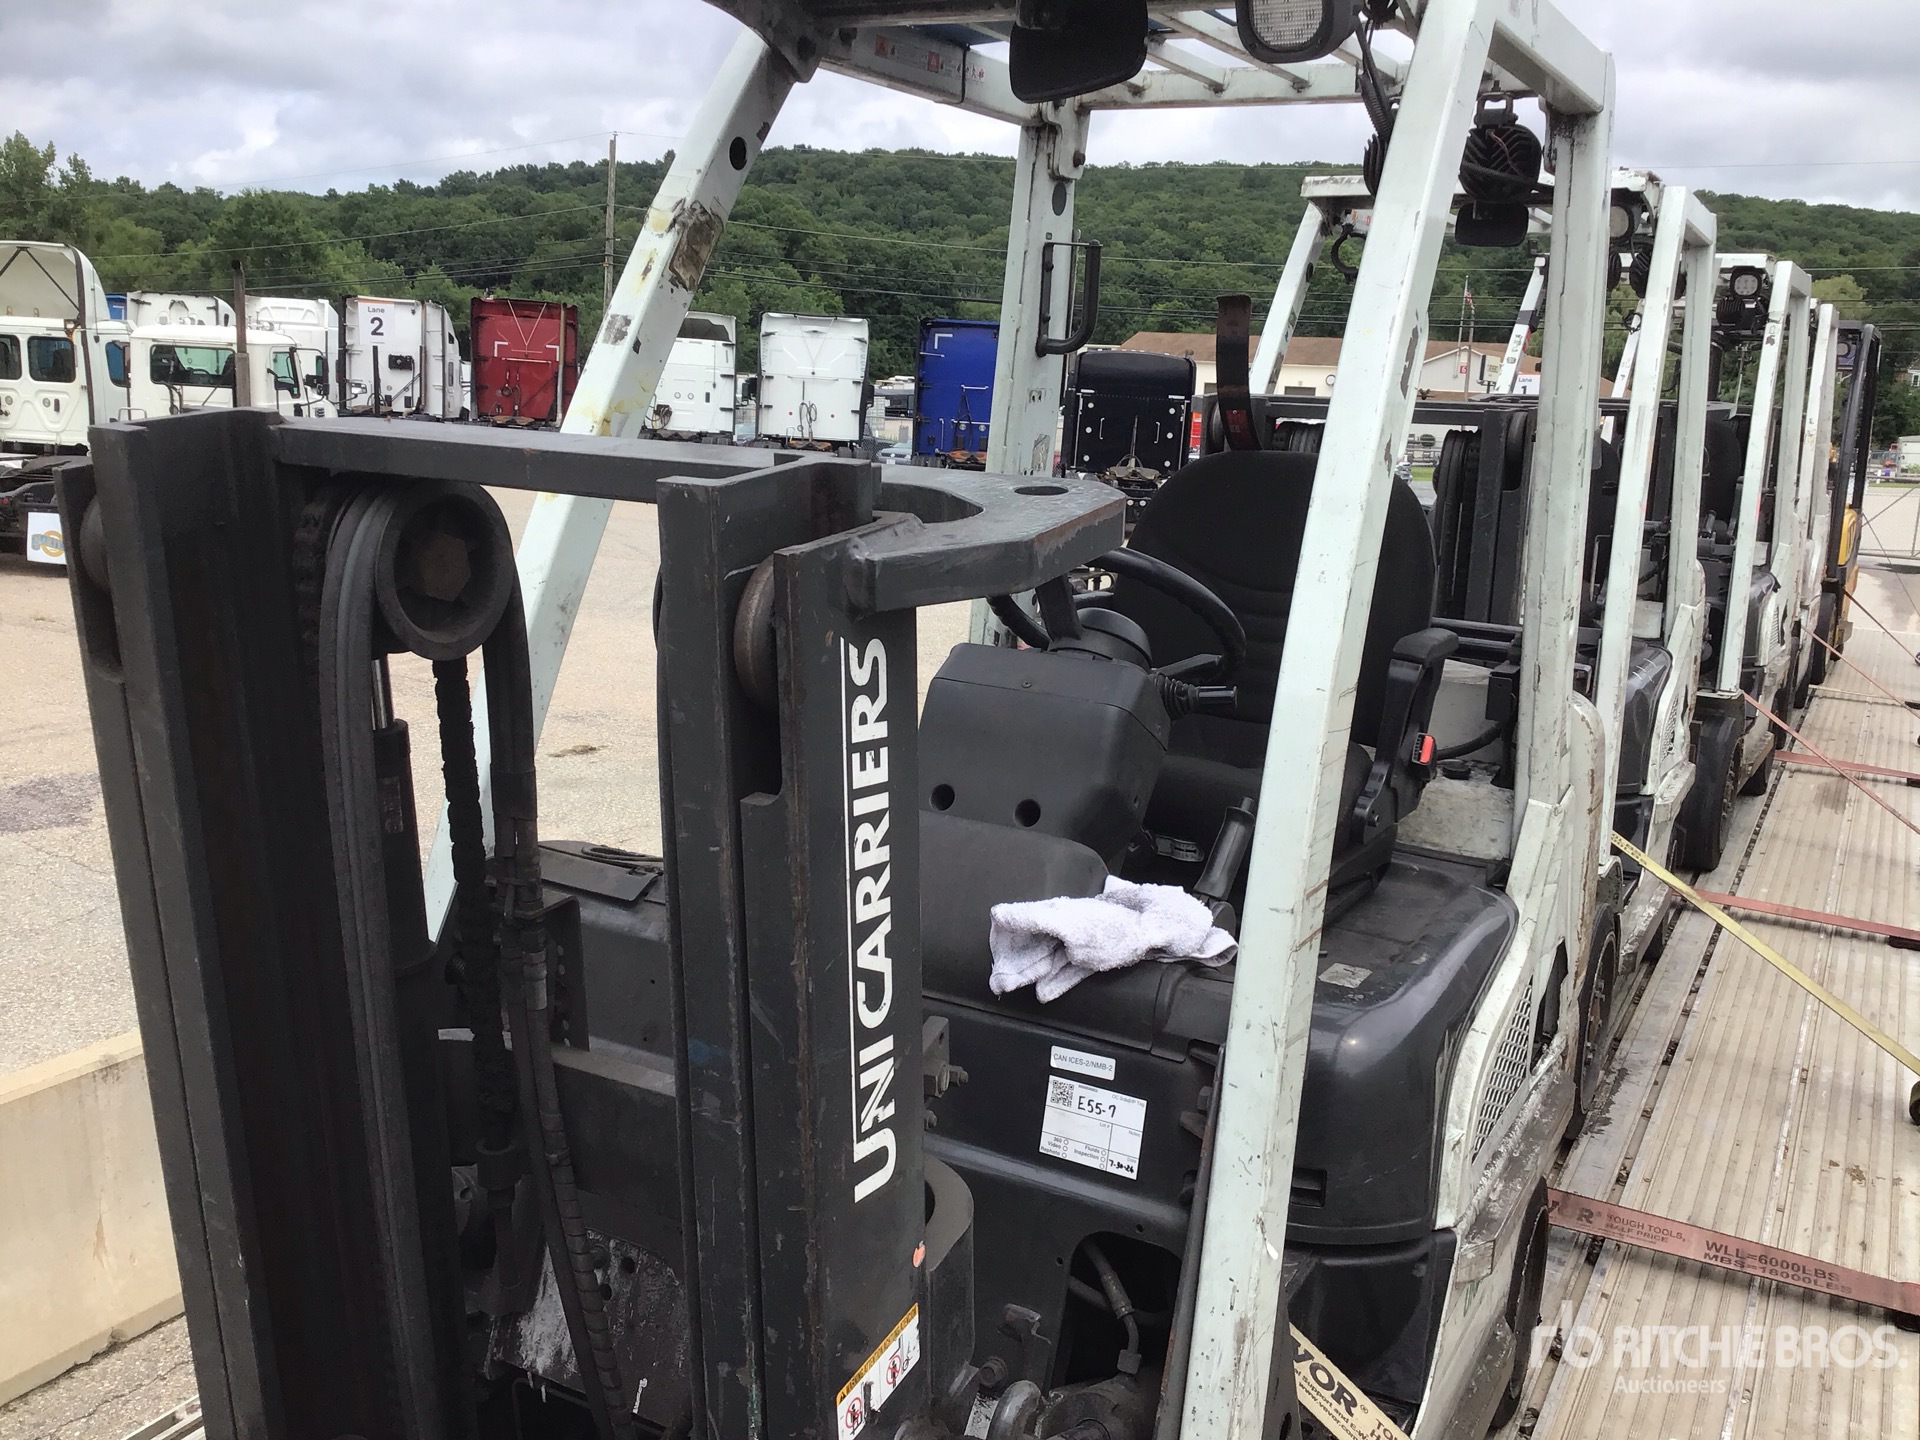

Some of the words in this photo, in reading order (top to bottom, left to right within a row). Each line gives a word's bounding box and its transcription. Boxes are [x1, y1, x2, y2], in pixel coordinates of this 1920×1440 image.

[367, 306, 386, 314] Lane
[370, 316, 385, 337] 2
[847, 637, 897, 1204] UNICARRIERS
[1053, 1053, 1067, 1063] CAN
[1068, 1056, 1114, 1072] ICES-2/NMB-2
[1047, 1141, 1062, 1150] Video
[1073, 1148, 1100, 1161] Inspection
[1084, 1144, 1100, 1154] Fluids
[1705, 1239, 1841, 1283] WLL=6000LBS
[1301, 1376, 1333, 1409] Support
[1333, 1408, 1350, 1424] and
